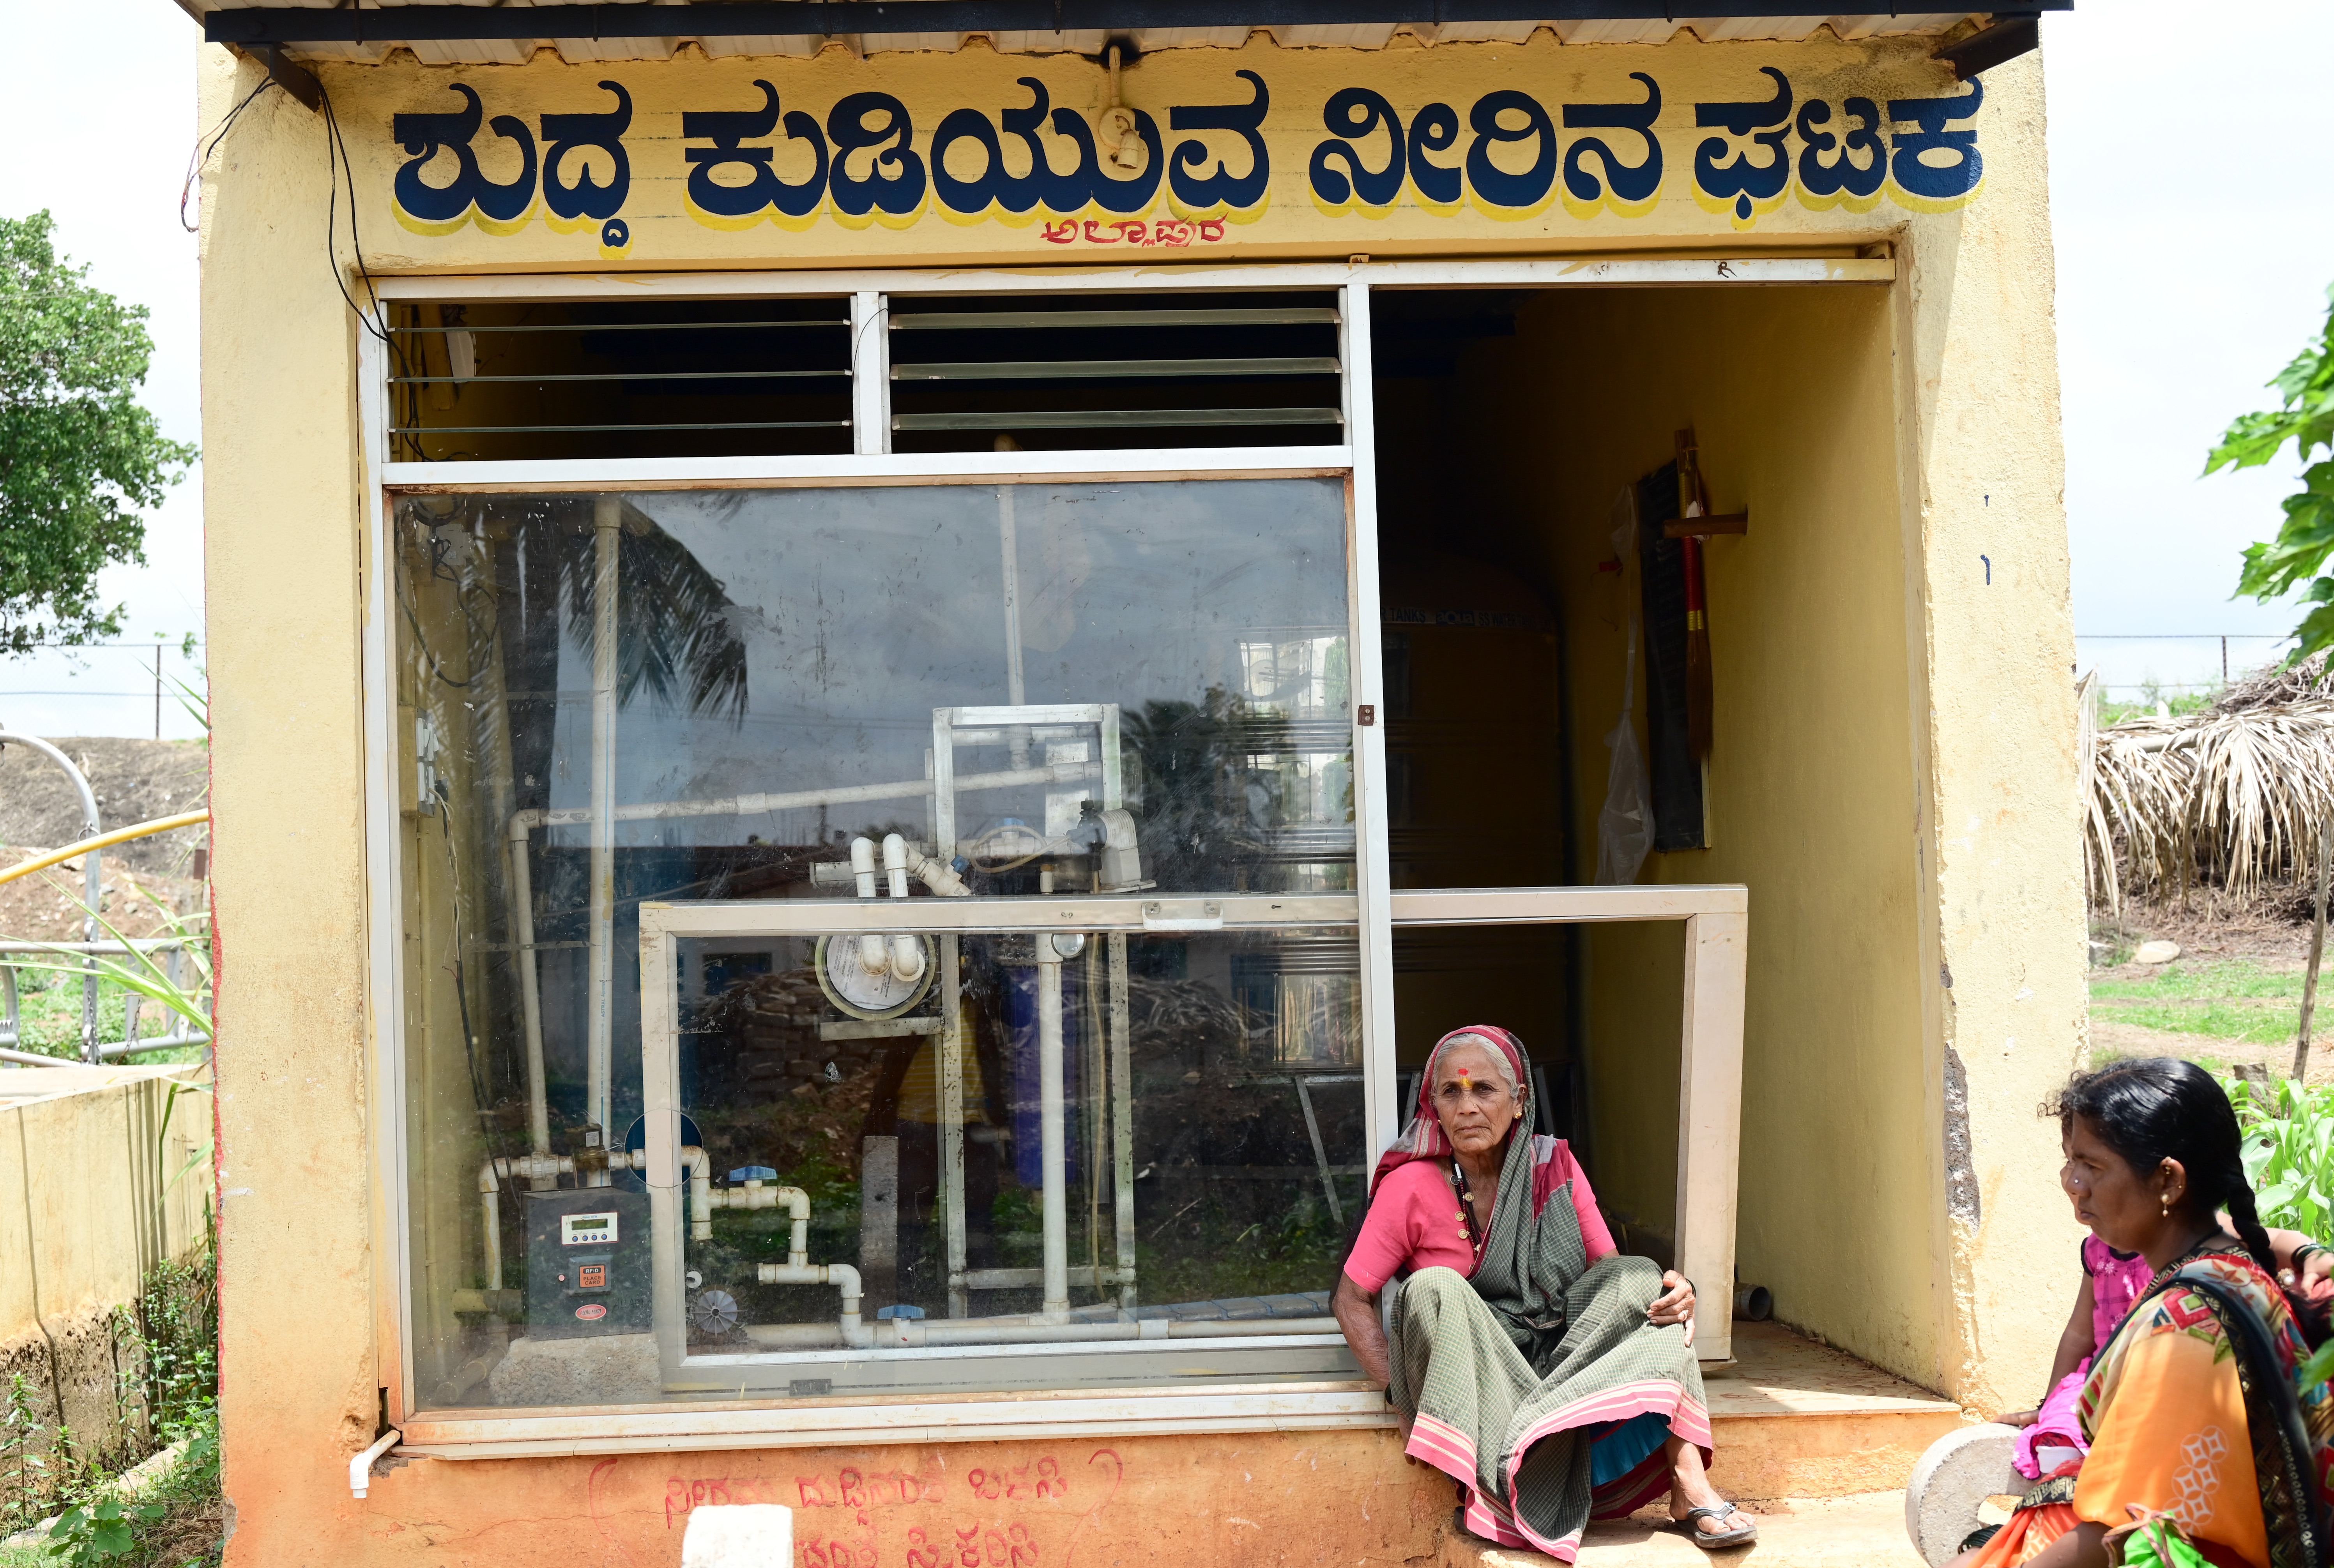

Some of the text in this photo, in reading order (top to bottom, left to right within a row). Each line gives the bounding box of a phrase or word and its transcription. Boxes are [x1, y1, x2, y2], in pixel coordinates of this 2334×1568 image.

[682, 69, 1270, 216] ಕುಡಿಯುವ
[1309, 72, 1663, 207] ನೀರಿನ
[1694, 66, 1983, 219] ಘಟಕ
[1390, 607, 1426, 623] TANKS
[1478, 612, 1490, 626] SS
[1492, 613, 1516, 627] WATER
